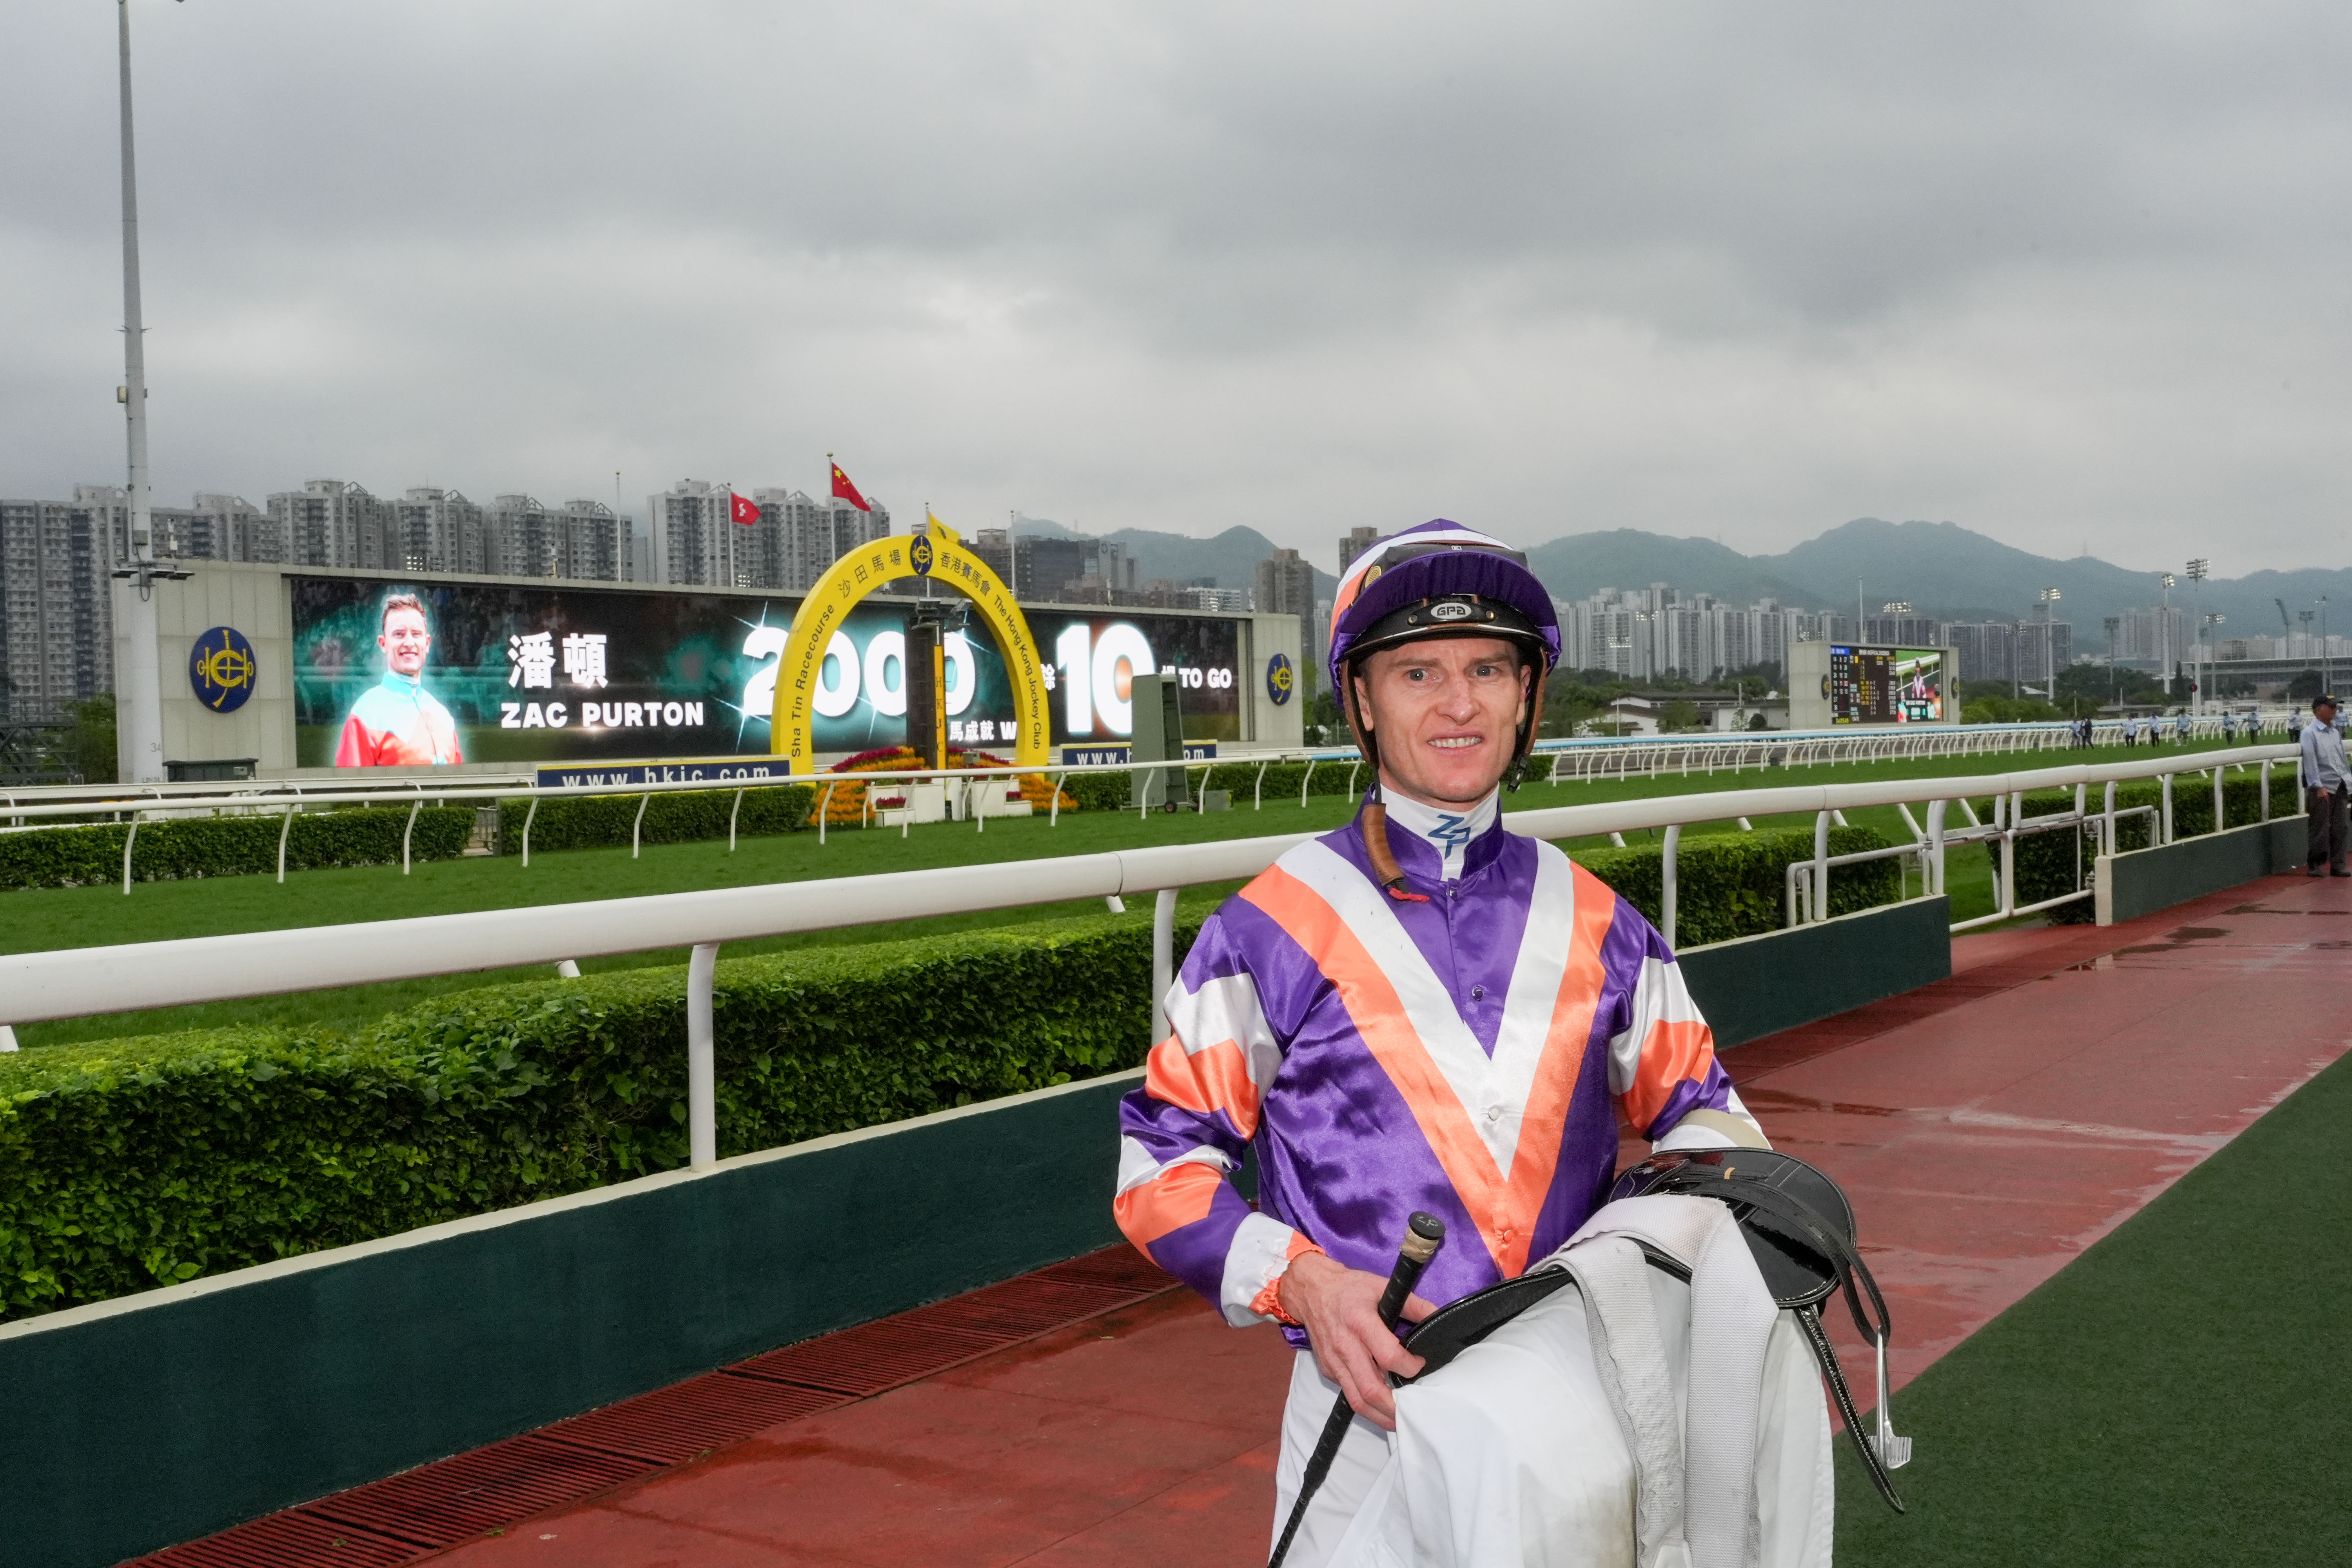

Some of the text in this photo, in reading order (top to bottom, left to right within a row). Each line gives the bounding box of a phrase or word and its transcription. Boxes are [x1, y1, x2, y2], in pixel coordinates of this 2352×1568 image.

[838, 549, 901, 599] 沙田馬場
[940, 552, 991, 597] 香港賽馬會
[508, 631, 608, 688] 潘頓
[743, 626, 975, 717] 2000
[792, 605, 834, 757] Sha Tin Racecourse
[995, 595, 1007, 617] The
[1005, 614, 1022, 646] Hong
[1019, 644, 1033, 676] Kong
[1029, 678, 1039, 719] Jockey
[1057, 625, 1155, 733] 10
[1179, 668, 1203, 688] TO
[1207, 668, 1232, 688] GO
[501, 702, 704, 728] ZAC PURTON
[949, 720, 994, 741] 馬成就
